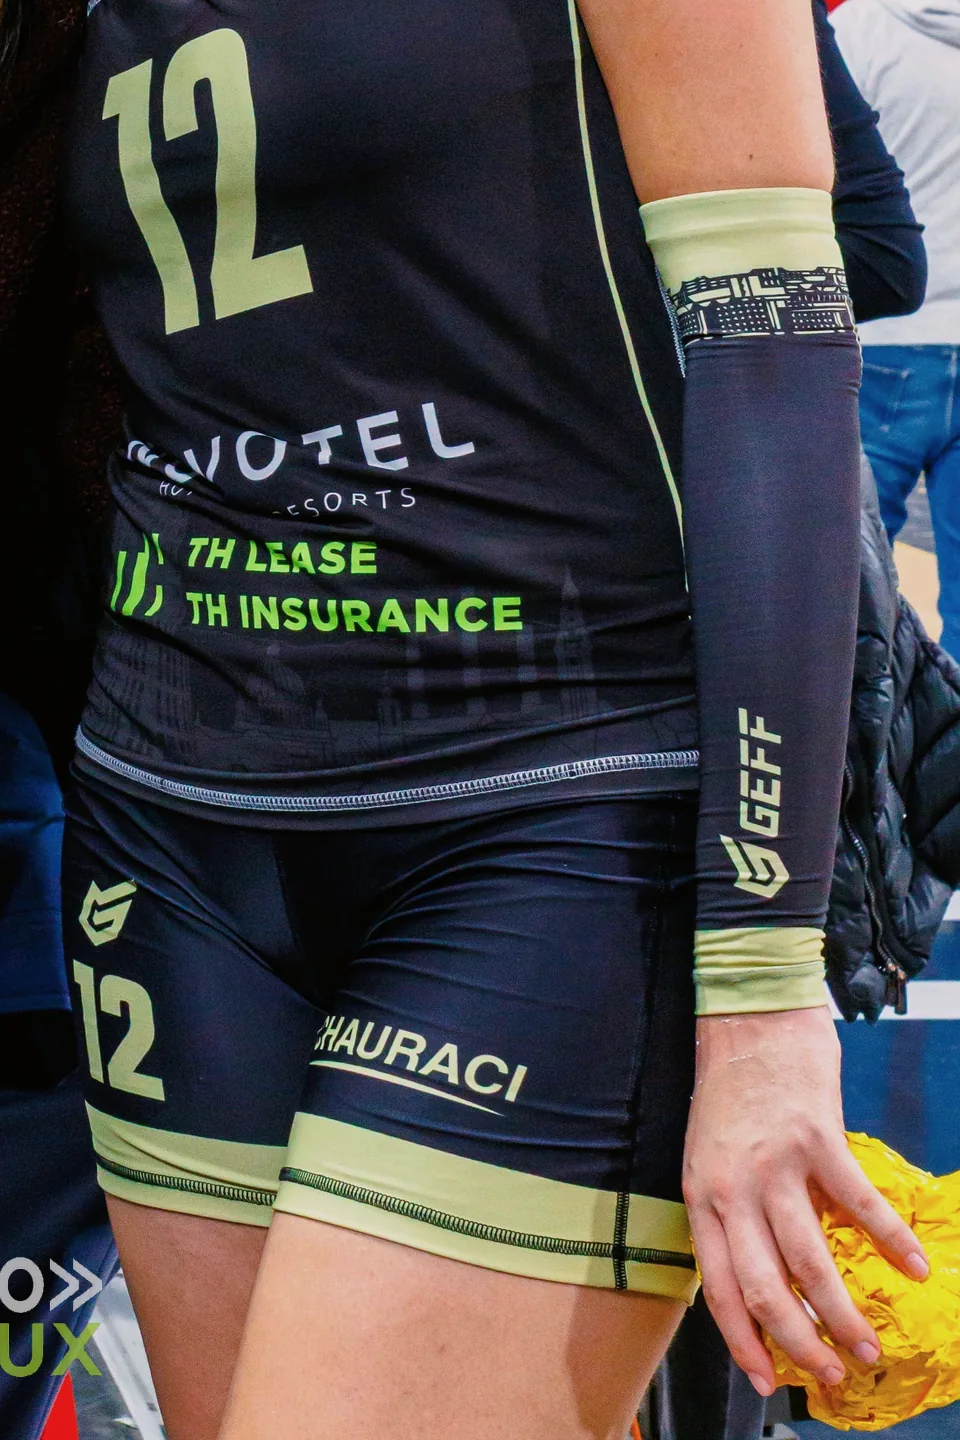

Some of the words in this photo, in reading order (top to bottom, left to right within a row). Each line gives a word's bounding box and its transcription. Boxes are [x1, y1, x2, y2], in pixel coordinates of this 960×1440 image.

[102, 28, 313, 335] 12
[186, 592, 229, 627] TH
[240, 596, 523, 633] INSURANCE
[187, 537, 236, 569] TH
[245, 540, 378, 574] LEASE
[738, 707, 782, 838] GEFF
[73, 959, 166, 1102] 12
